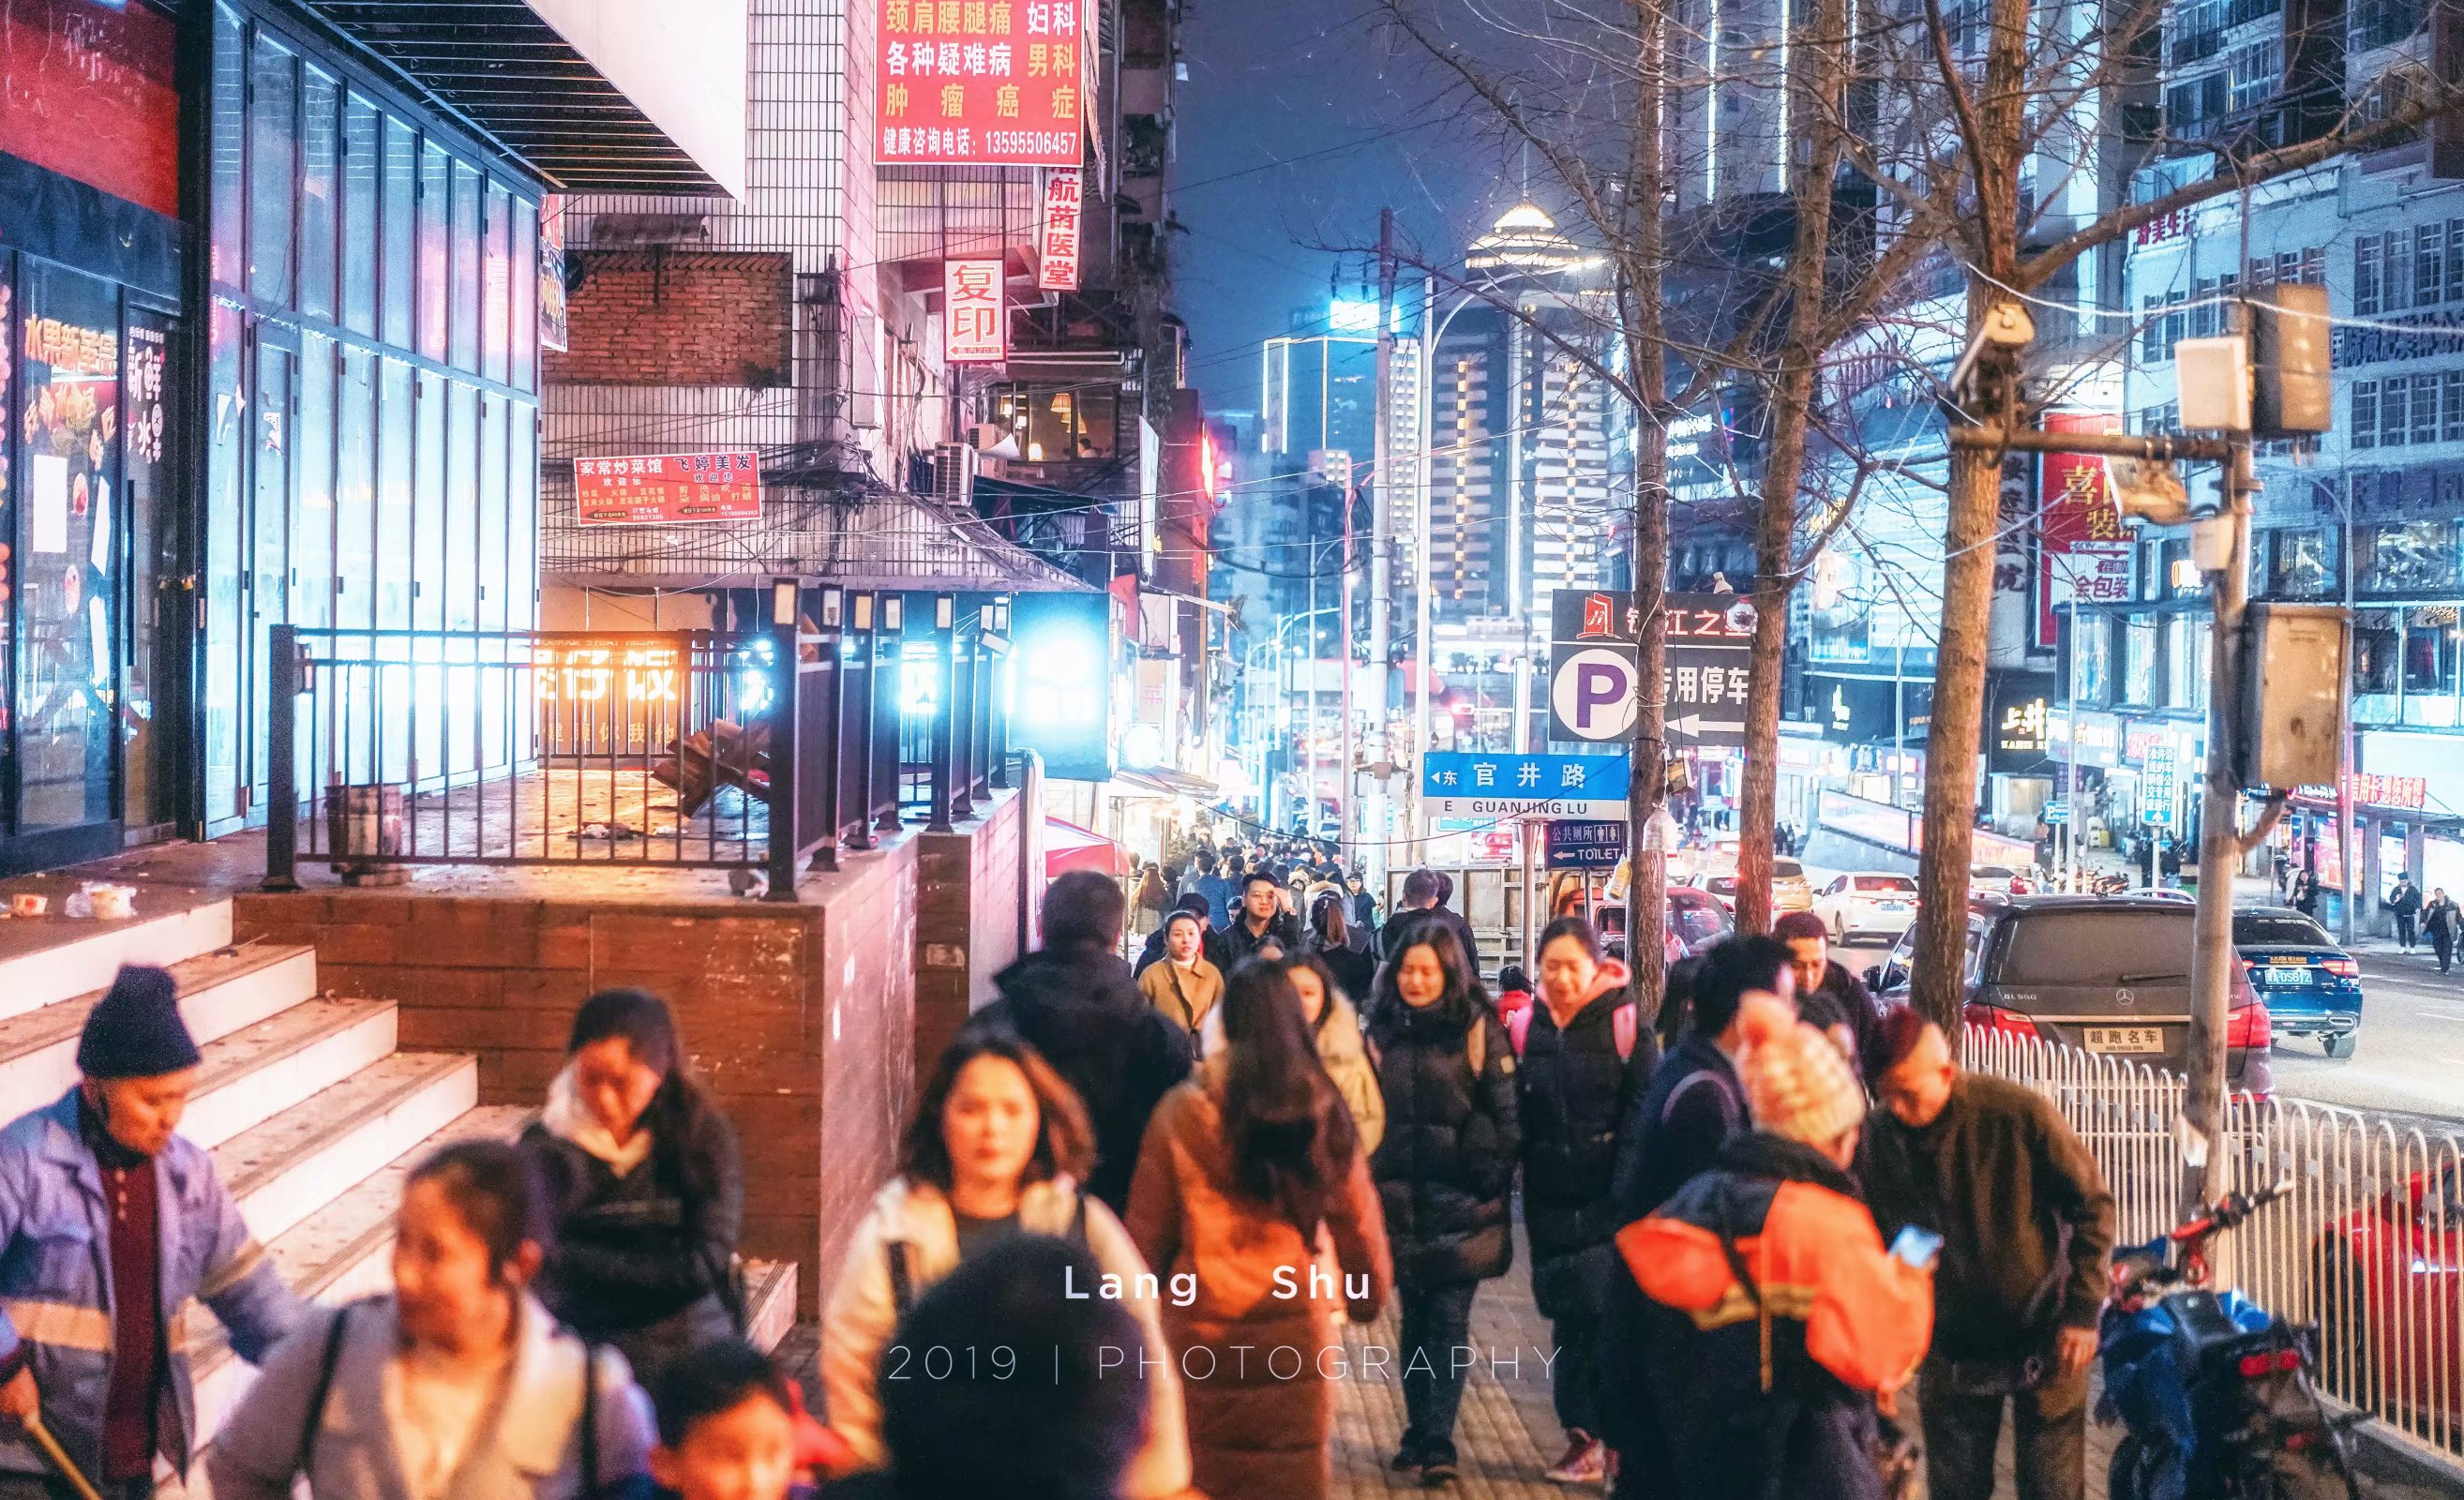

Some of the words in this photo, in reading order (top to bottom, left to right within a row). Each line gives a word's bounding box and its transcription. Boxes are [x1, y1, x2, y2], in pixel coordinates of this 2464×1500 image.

[886, 0, 1012, 35] 颈肩腰腿痛
[1027, 1, 1075, 36] 妇科
[886, 41, 1012, 77] 各种疑难病
[1027, 43, 1075, 78] 男科
[985, 130, 1077, 156] 13595506457
[1044, 168, 1079, 285] 航苗医堂
[952, 264, 997, 343] 复印
[580, 458, 663, 476] 家常炒菜馆
[674, 455, 751, 472] 飞婷美发
[694, 472, 733, 483] 欢迎您
[1627, 607, 1751, 637] 江之
[1576, 663, 1628, 728] P
[2002, 698, 2046, 740] 上井
[1443, 770, 1458, 786] 东
[1472, 762, 1586, 788] 官井路
[1444, 800, 1452, 812] E
[1472, 801, 1562, 814] GUANJING
[1567, 802, 1587, 815] LU
[1553, 825, 1593, 842] 公共厕所
[1577, 848, 1620, 861] TOILET
[2090, 1029, 2157, 1043] 超跑名车
